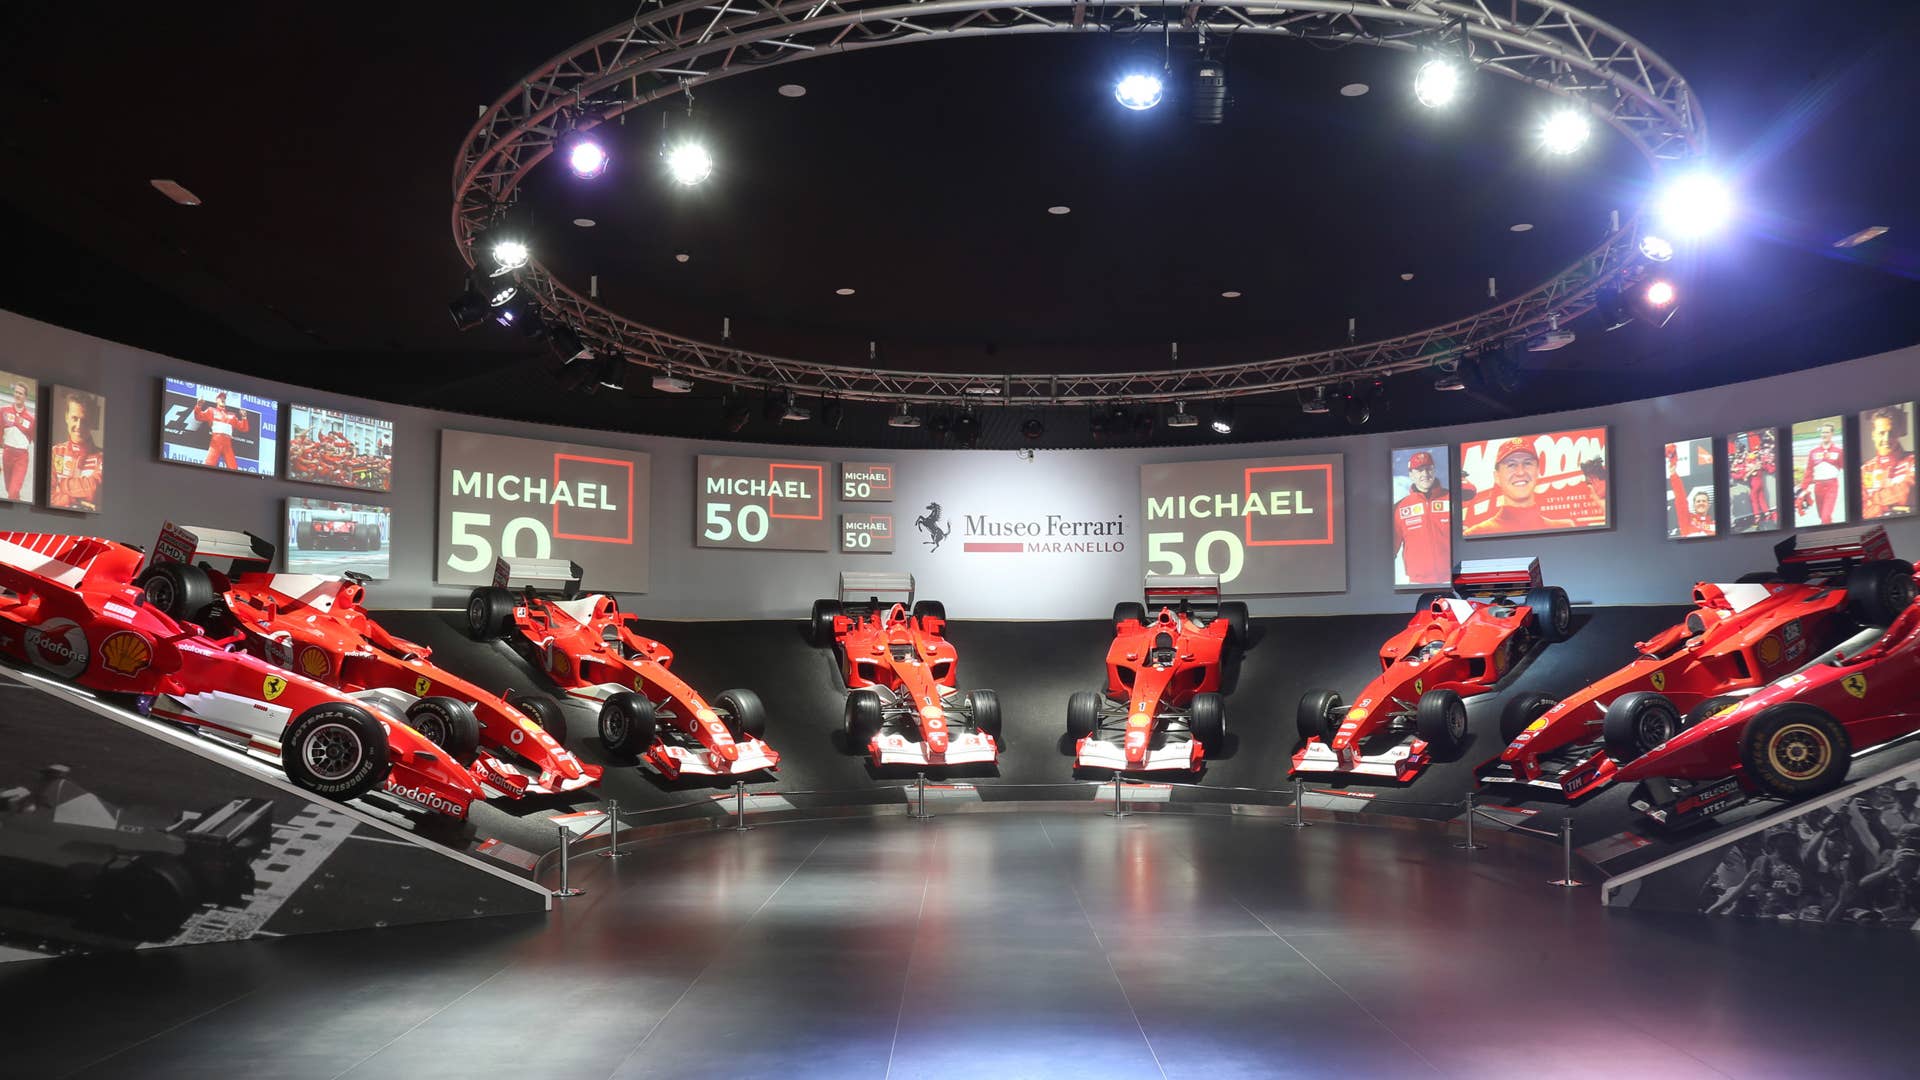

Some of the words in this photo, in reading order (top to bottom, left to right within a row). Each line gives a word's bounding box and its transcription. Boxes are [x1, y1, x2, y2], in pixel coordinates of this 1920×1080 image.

[242, 393, 271, 408] Allianz
[846, 472, 887, 481] MICHAEL
[452, 469, 617, 511] MICHAEL
[707, 477, 811, 499] MICHAEL
[845, 482, 870, 497] 50
[1147, 490, 1313, 520] MICHAEL
[704, 502, 769, 543] 50
[845, 522, 888, 531] MICHAEL
[964, 514, 1041, 537] Museo
[1045, 514, 1124, 537] Ferrari
[446, 511, 552, 573] 50
[845, 532, 871, 548] 50
[1027, 542, 1125, 553] MARANELLO
[1147, 530, 1245, 585] 50
[26, 630, 87, 663] vodafone
[476, 765, 524, 796] vodafone
[1566, 776, 1584, 792] TIM
[1699, 780, 1739, 801] TELECOM
[387, 780, 463, 815] vodafone
